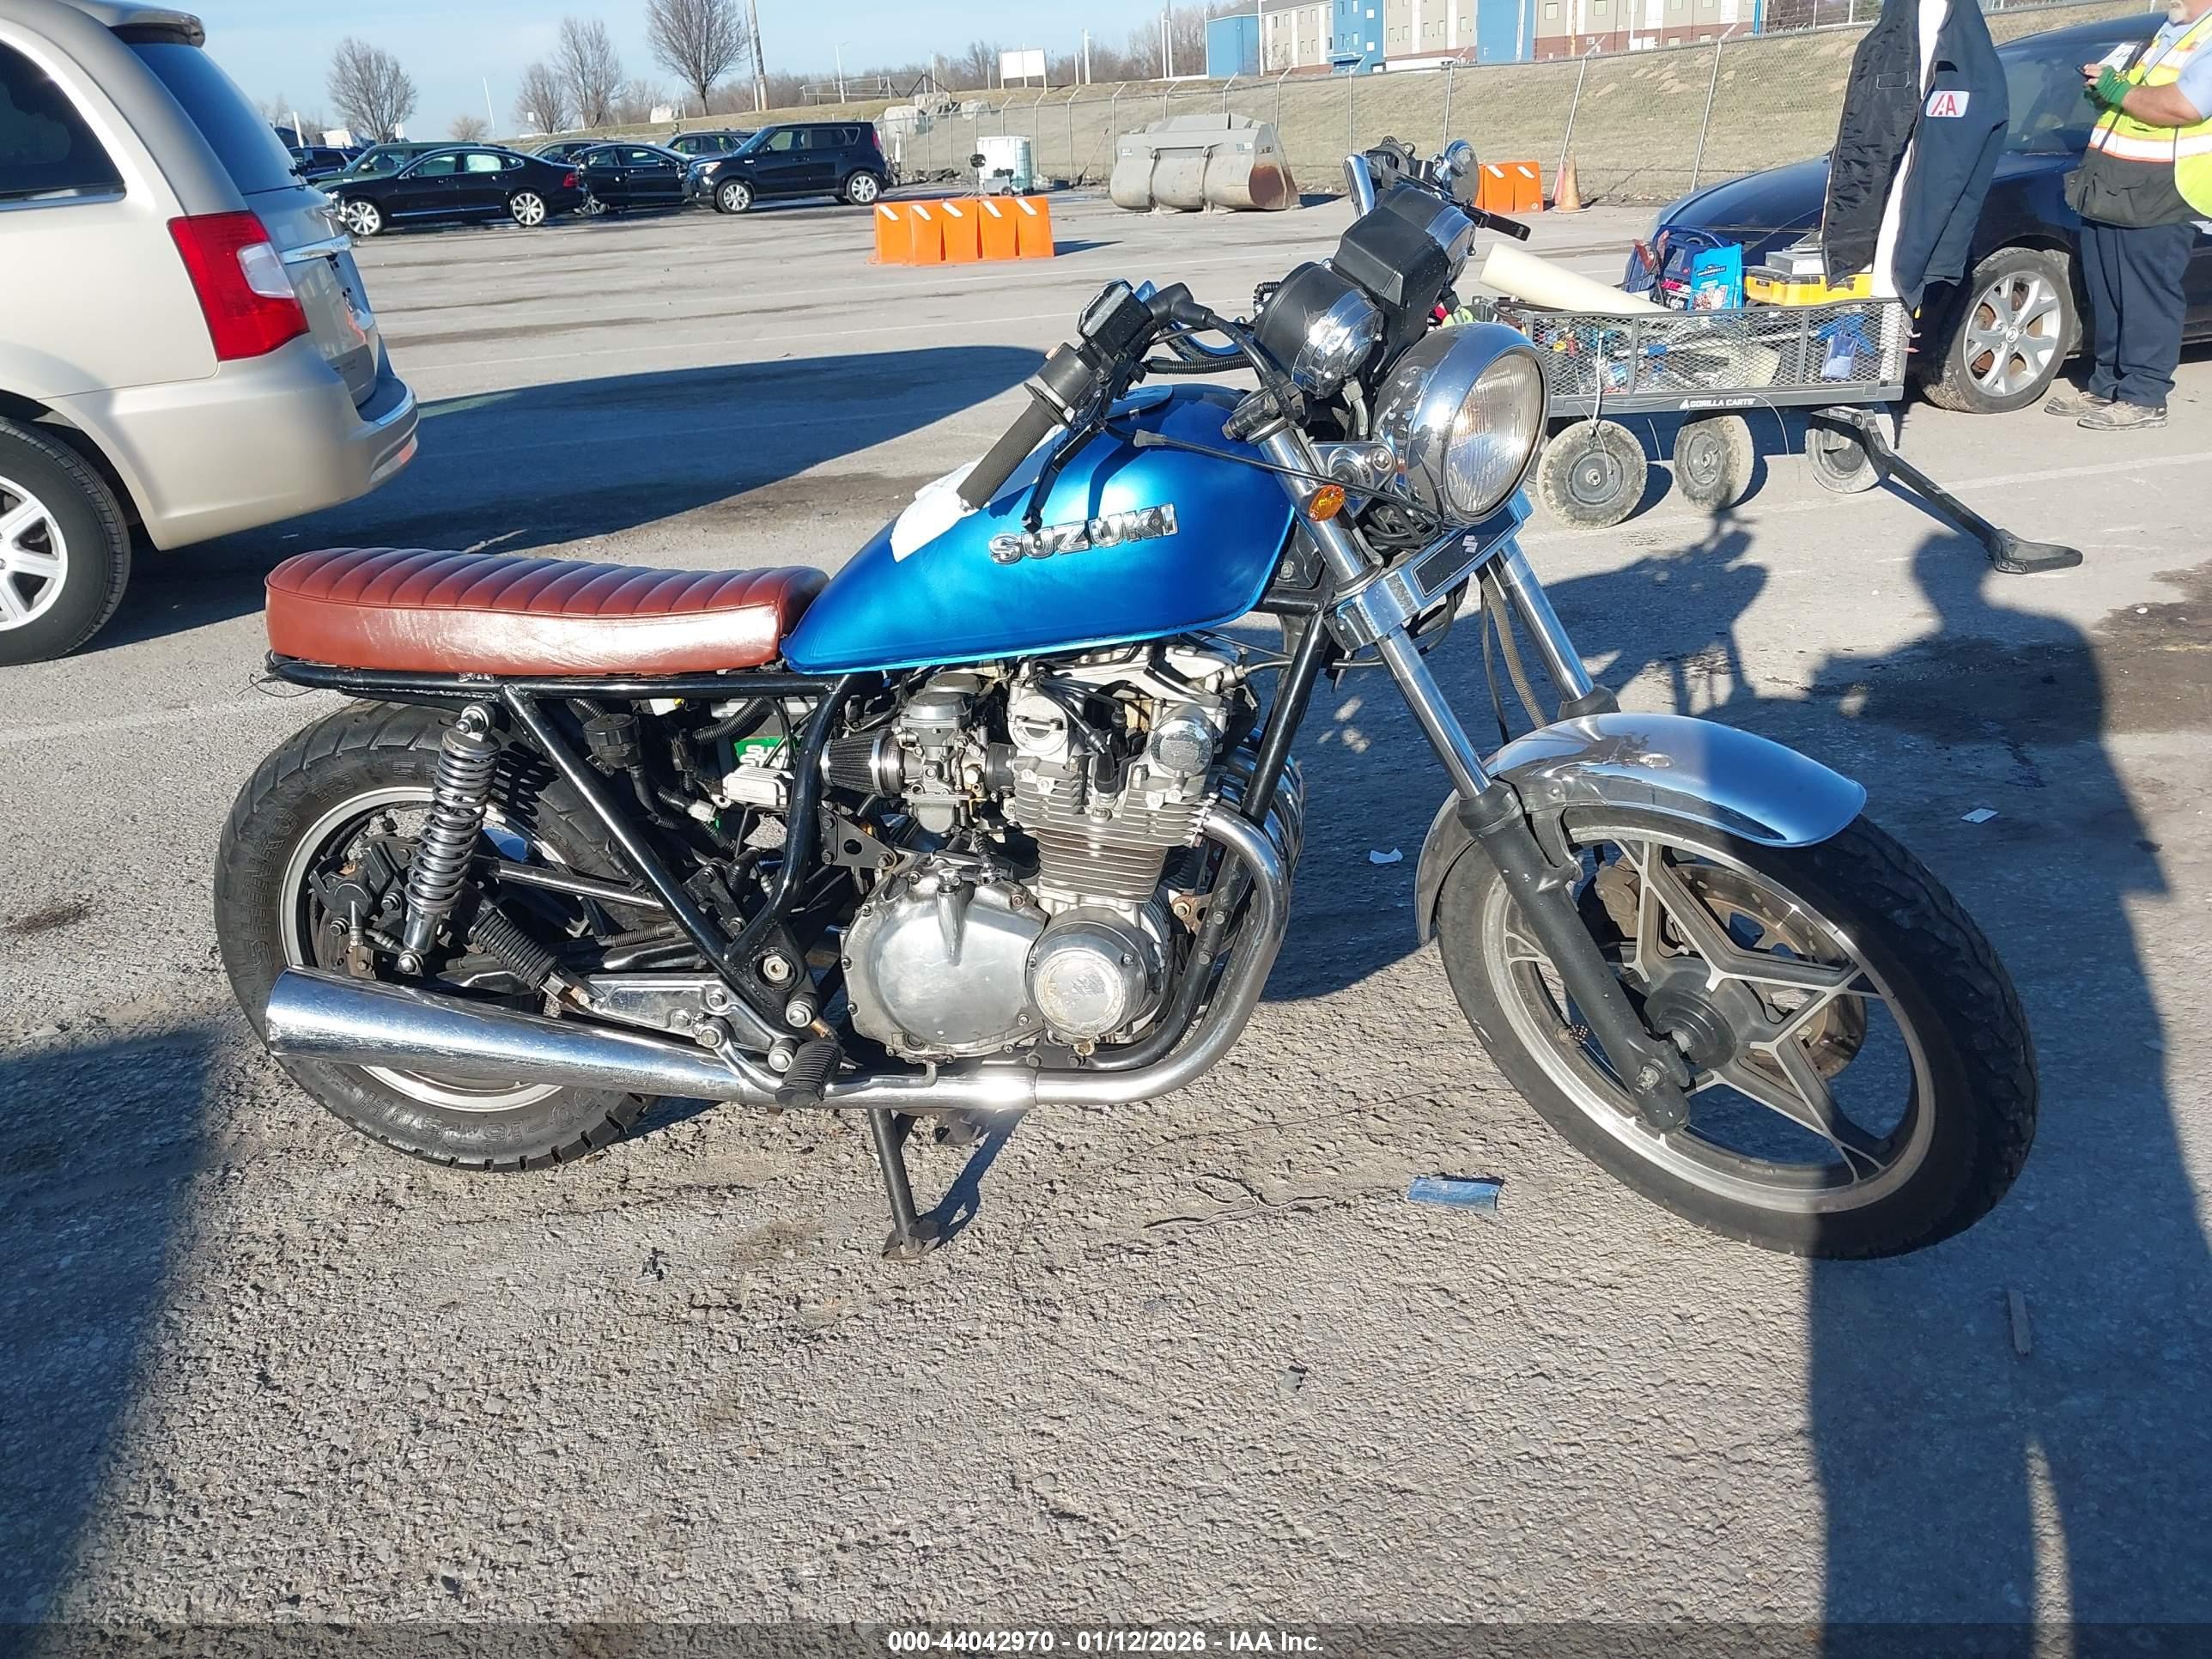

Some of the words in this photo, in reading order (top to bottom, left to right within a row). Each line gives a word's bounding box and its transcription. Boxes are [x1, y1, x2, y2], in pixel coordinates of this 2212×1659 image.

[1689, 399, 1724, 408] GORILLA
[1725, 398, 1754, 407] CARTS
[989, 502, 1178, 564] SUZUKI
[240, 807, 300, 967] SHINKO
